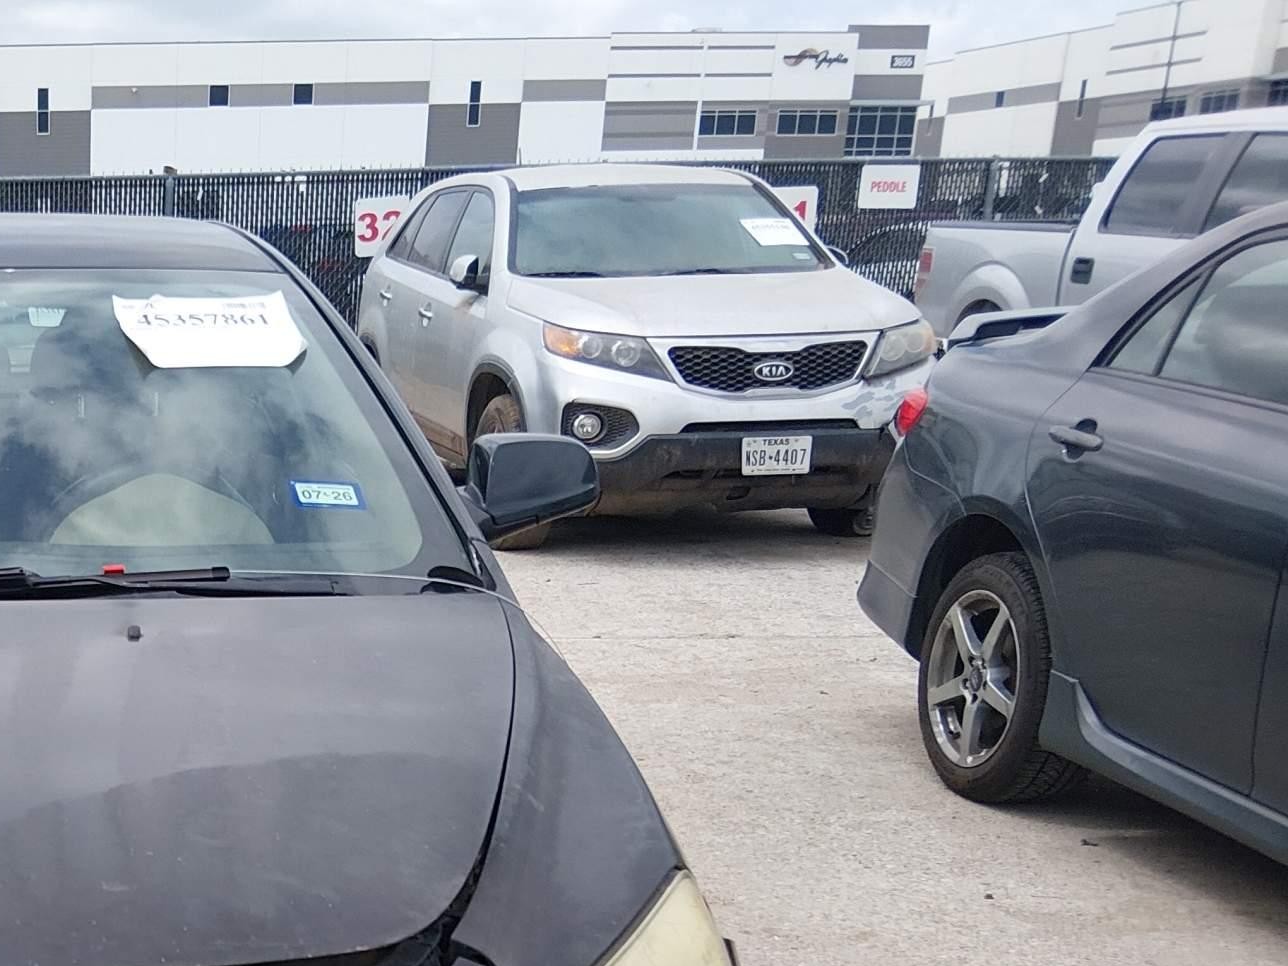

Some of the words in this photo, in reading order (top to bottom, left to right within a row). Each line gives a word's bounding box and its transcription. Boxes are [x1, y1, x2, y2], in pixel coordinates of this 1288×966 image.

[870, 181, 907, 193] PEDDLE
[762, 366, 786, 377] KIA
[763, 438, 790, 446] TEXAS
